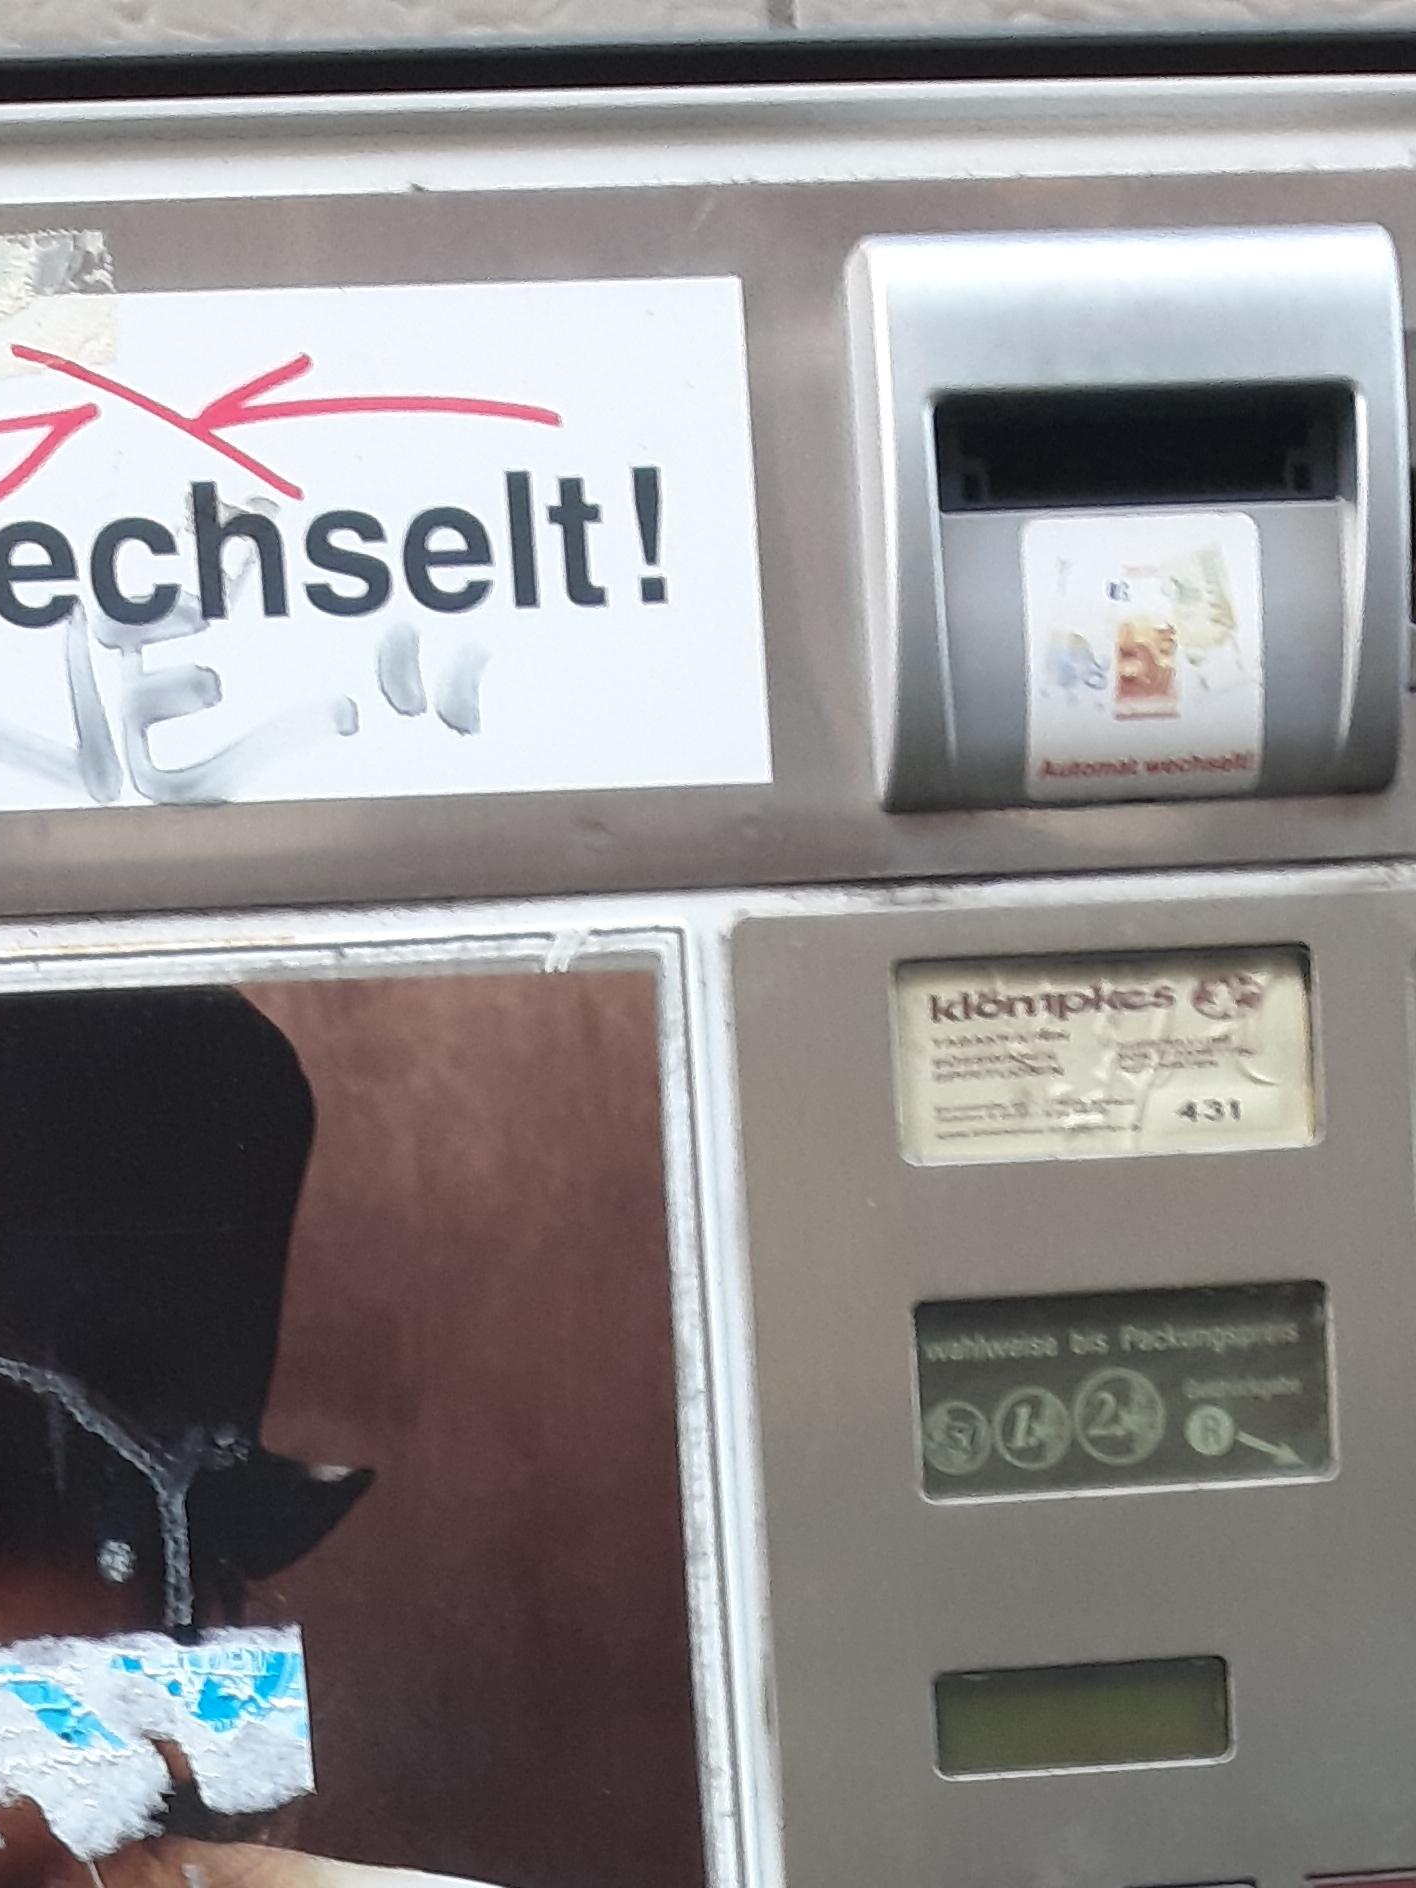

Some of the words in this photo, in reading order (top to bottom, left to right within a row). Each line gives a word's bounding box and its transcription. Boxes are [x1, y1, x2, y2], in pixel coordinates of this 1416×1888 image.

[1039, 758, 1138, 779] Automat
[1176, 1098, 1243, 1122] 431
[1069, 1328, 1109, 1354] bis
